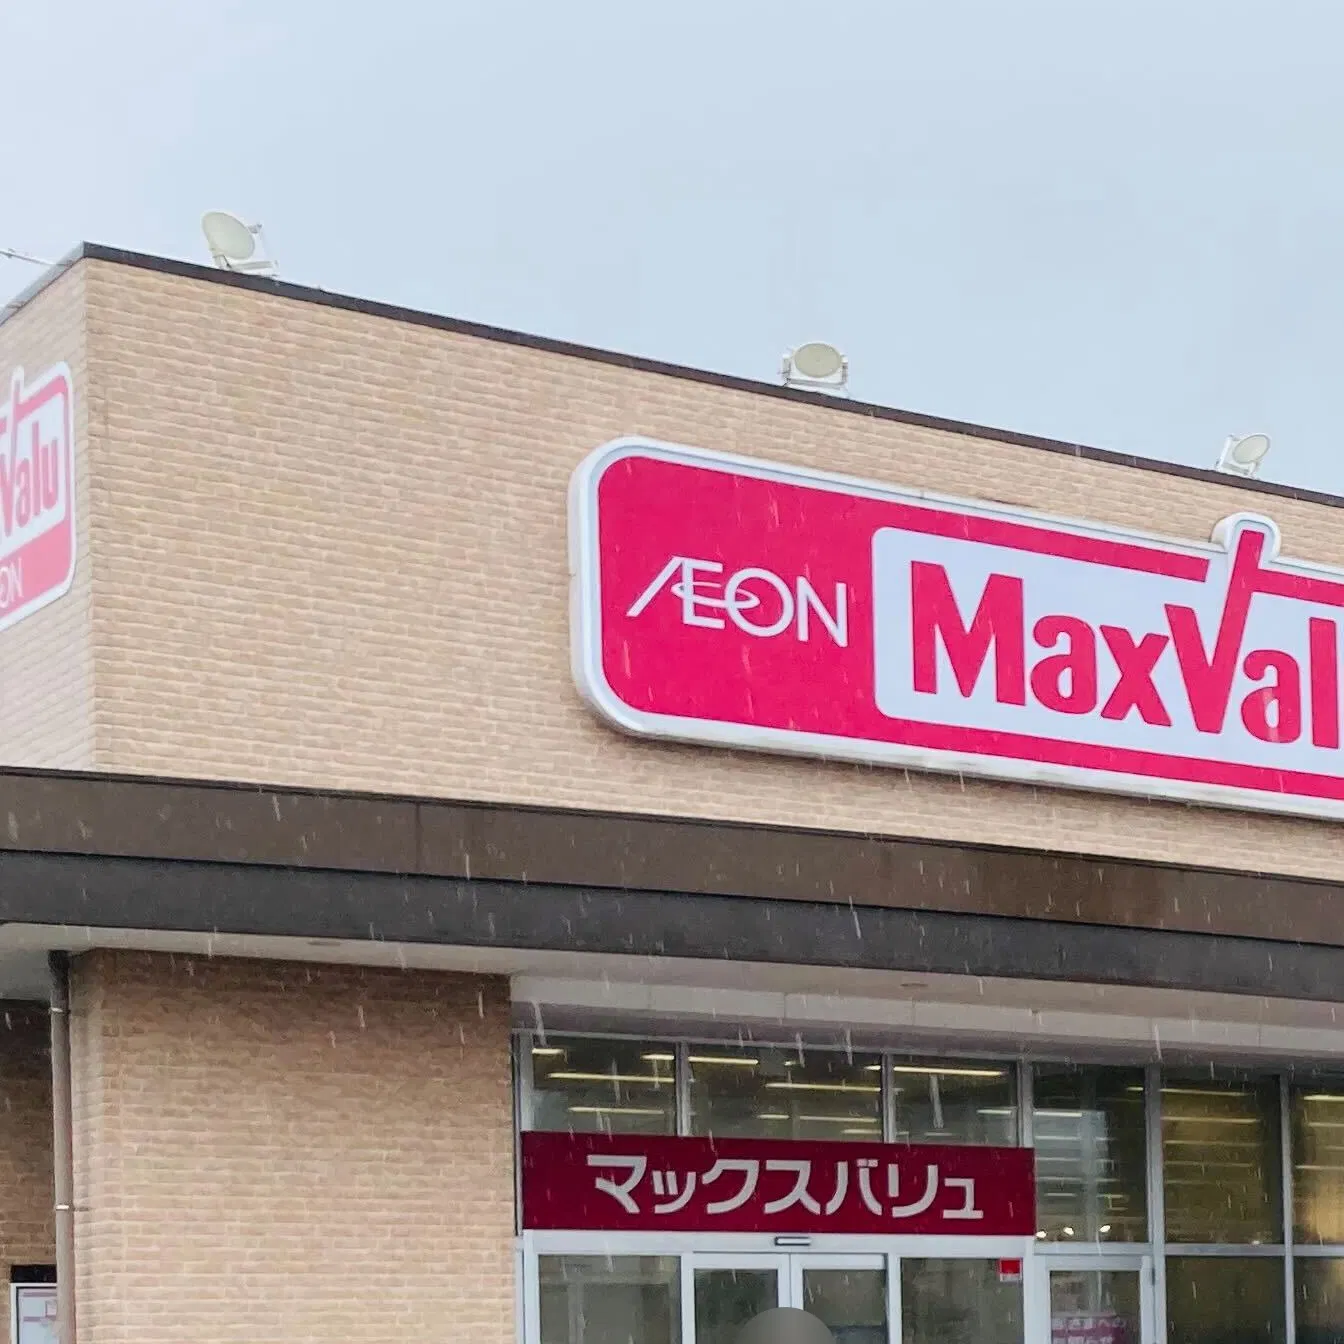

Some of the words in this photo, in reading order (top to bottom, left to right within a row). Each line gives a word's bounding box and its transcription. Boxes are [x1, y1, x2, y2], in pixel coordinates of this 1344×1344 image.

[0, 380, 58, 537] Valu
[587, 1155, 984, 1219] マックスバリュ
